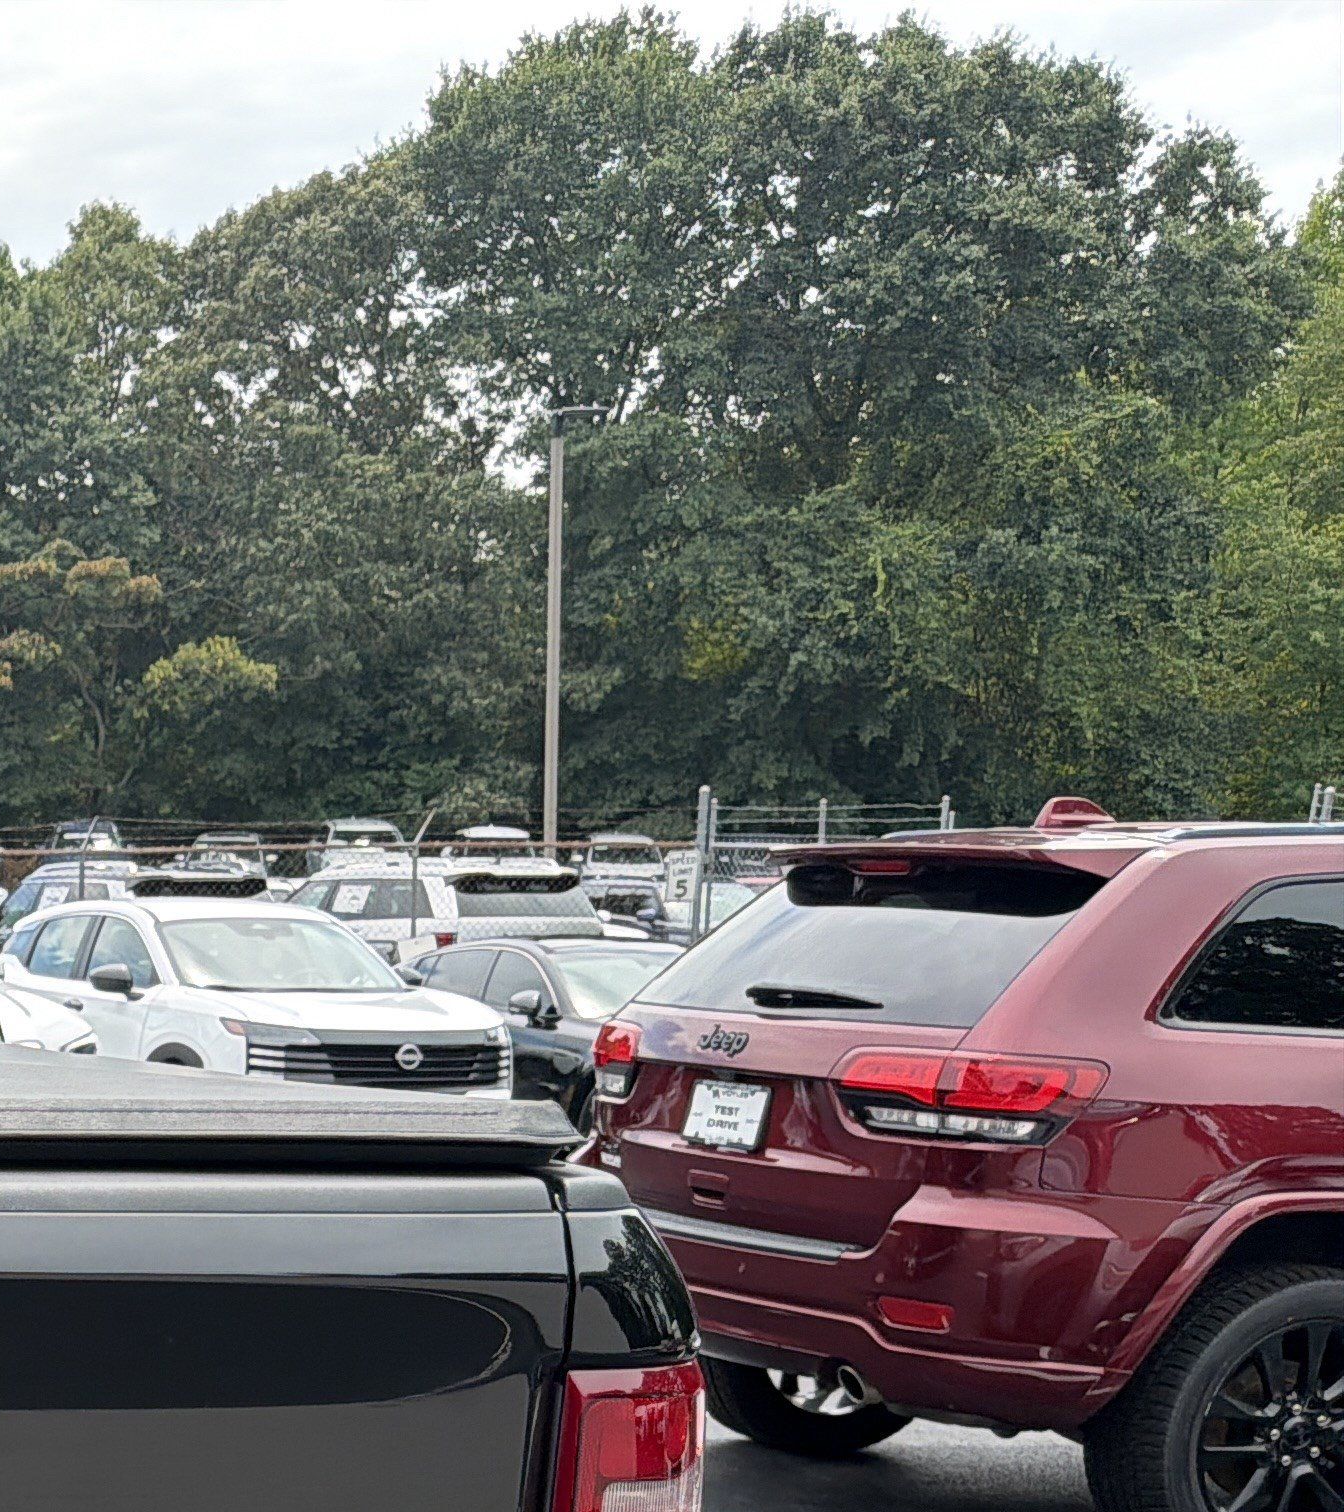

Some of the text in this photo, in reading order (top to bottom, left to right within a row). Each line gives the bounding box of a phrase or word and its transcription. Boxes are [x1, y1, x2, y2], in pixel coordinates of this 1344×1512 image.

[696, 1023, 749, 1058] Jeep
[714, 1104, 740, 1117] TEST
[706, 1118, 740, 1131] DRIVE
